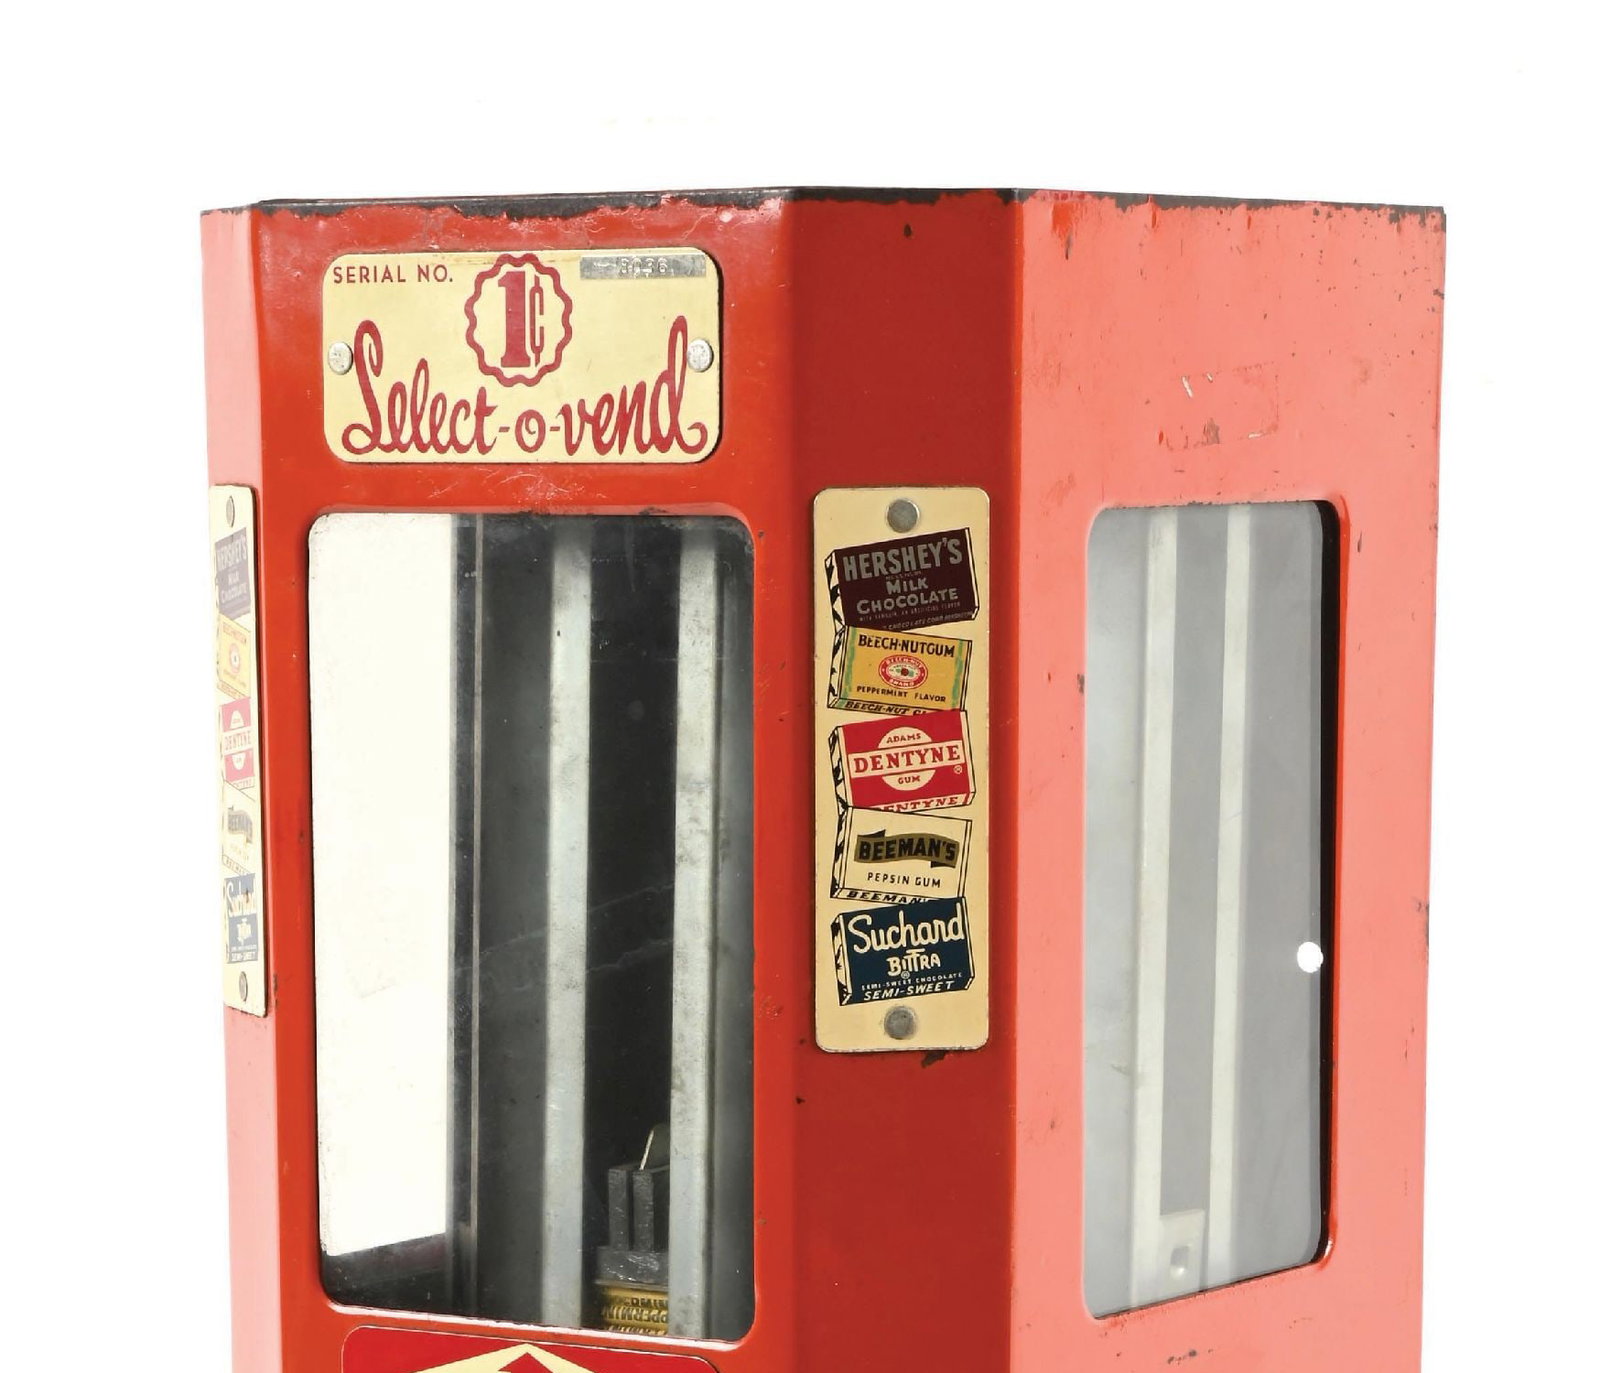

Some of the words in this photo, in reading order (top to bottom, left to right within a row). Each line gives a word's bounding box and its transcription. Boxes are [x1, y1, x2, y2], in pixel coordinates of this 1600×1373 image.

[333, 263, 407, 284] SERIAL
[417, 263, 454, 283] NO.
[341, 315, 709, 457] Select-o-vend
[842, 537, 963, 582] HERSHEY'S
[856, 587, 959, 615] CHOCOLATE
[856, 685, 908, 699] PEPPERMINT
[914, 691, 947, 703] FLAVOR
[886, 733, 922, 744] ADAMS
[853, 744, 962, 775] DENTYNE
[897, 775, 921, 785] GUM
[858, 838, 957, 862] BEEMAN'S
[867, 872, 910, 885] PEPSIN
[915, 875, 941, 888] GUM
[847, 903, 965, 954] Suchard
[863, 980, 955, 1001] SEMI-SWEET
